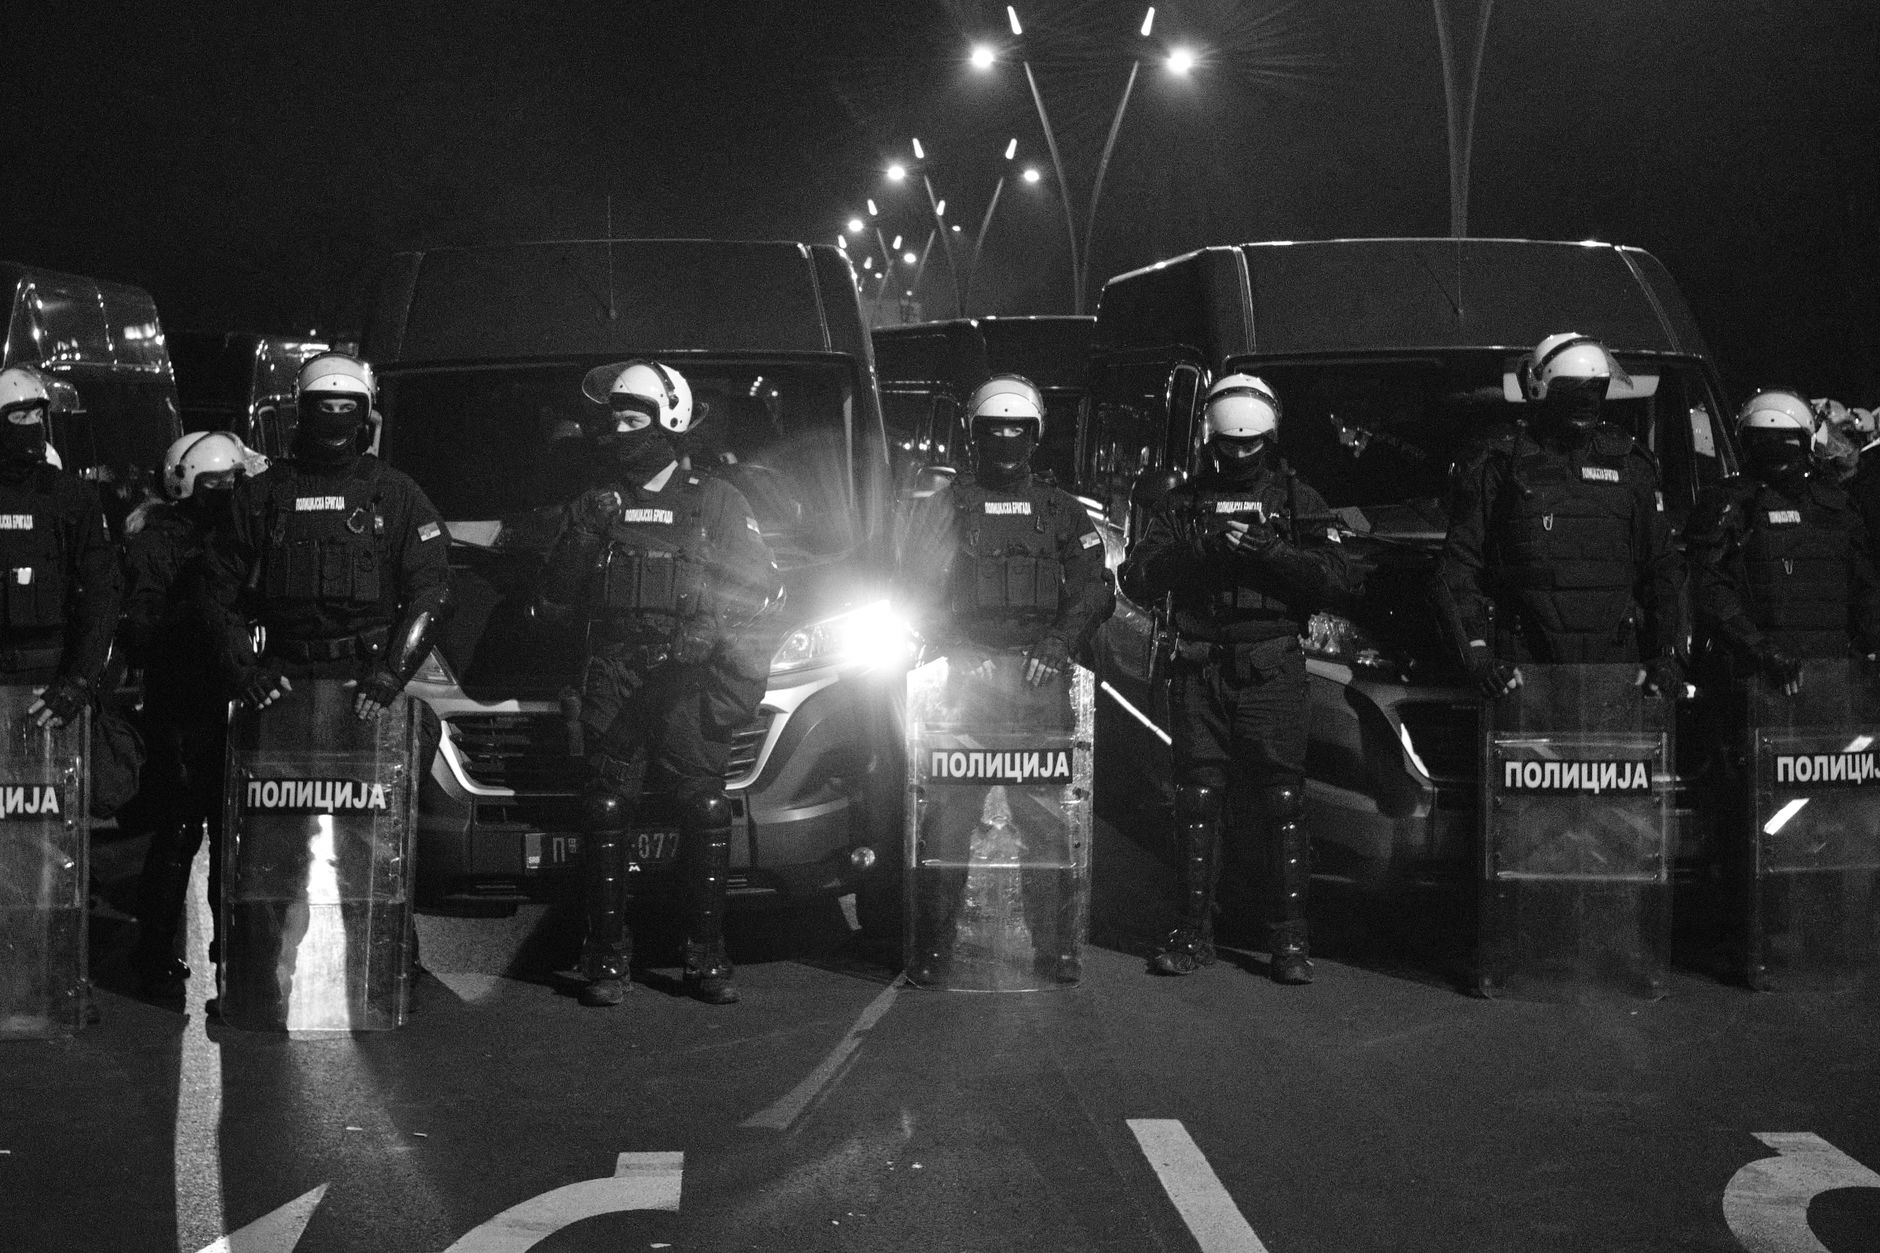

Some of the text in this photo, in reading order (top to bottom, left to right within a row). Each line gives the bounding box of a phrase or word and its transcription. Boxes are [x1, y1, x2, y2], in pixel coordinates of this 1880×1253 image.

[931, 752, 1070, 782] ПОЛИЦИЈА
[1505, 762, 1649, 793] ПОЛИЦИЈА
[248, 782, 386, 812] ПОЛИЦИЈА
